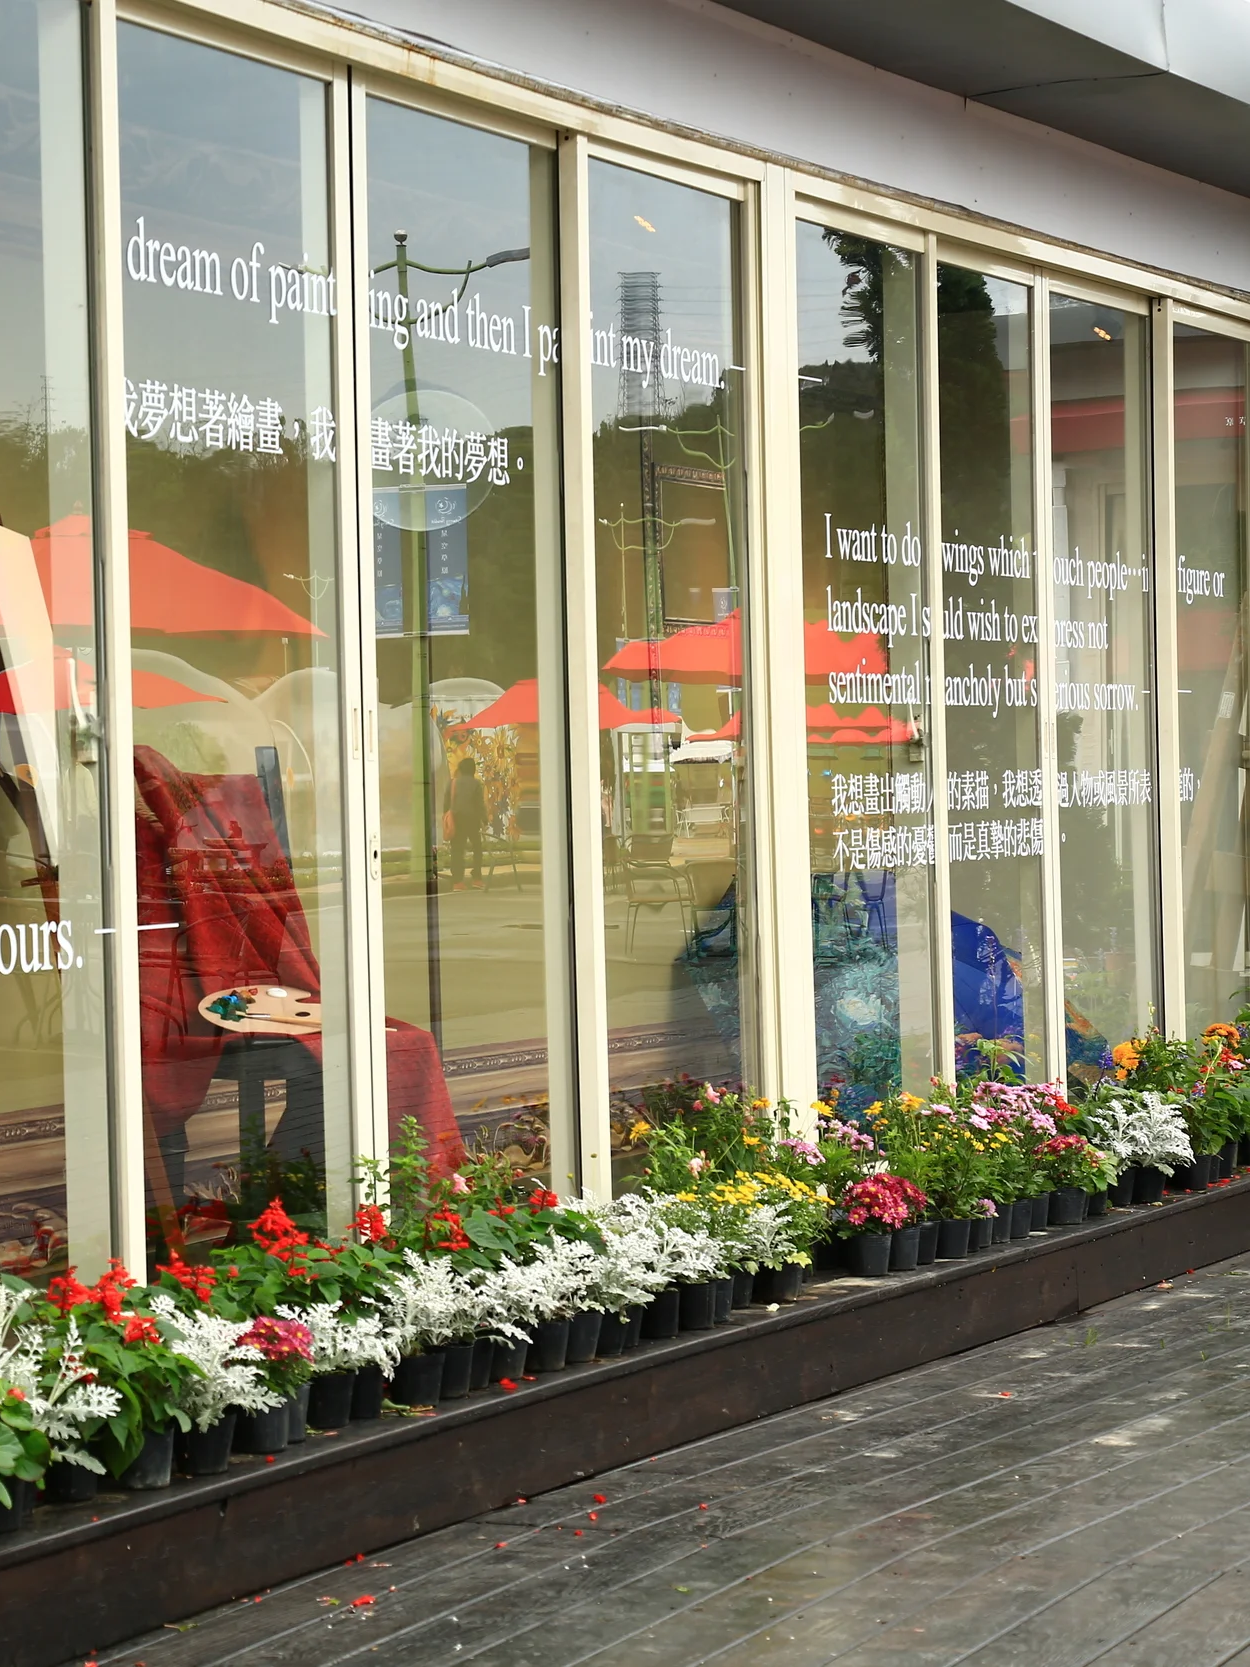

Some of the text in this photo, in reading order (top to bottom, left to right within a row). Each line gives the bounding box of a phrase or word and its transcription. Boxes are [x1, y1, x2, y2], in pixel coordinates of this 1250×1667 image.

[126, 216, 223, 296] dream
[231, 241, 265, 303] of
[415, 288, 460, 344] and
[466, 292, 517, 356] then
[521, 305, 533, 359] I
[621, 334, 656, 389] my
[660, 328, 725, 389] dream.
[824, 513, 833, 558] I
[836, 523, 878, 563] want
[881, 525, 897, 566] to
[902, 521, 921, 567] do
[987, 534, 1031, 579] which
[1032, 545, 1085, 587] ouch
[1177, 554, 1211, 605] figure
[1213, 571, 1225, 598] or
[826, 585, 907, 648] landscape
[910, 592, 918, 637] I
[967, 598, 1002, 643] wish
[1004, 605, 1018, 644] to
[1087, 615, 1109, 650] not
[828, 657, 922, 705] sentimental
[1004, 663, 1028, 707] but
[1094, 682, 1139, 712] sorrow.
